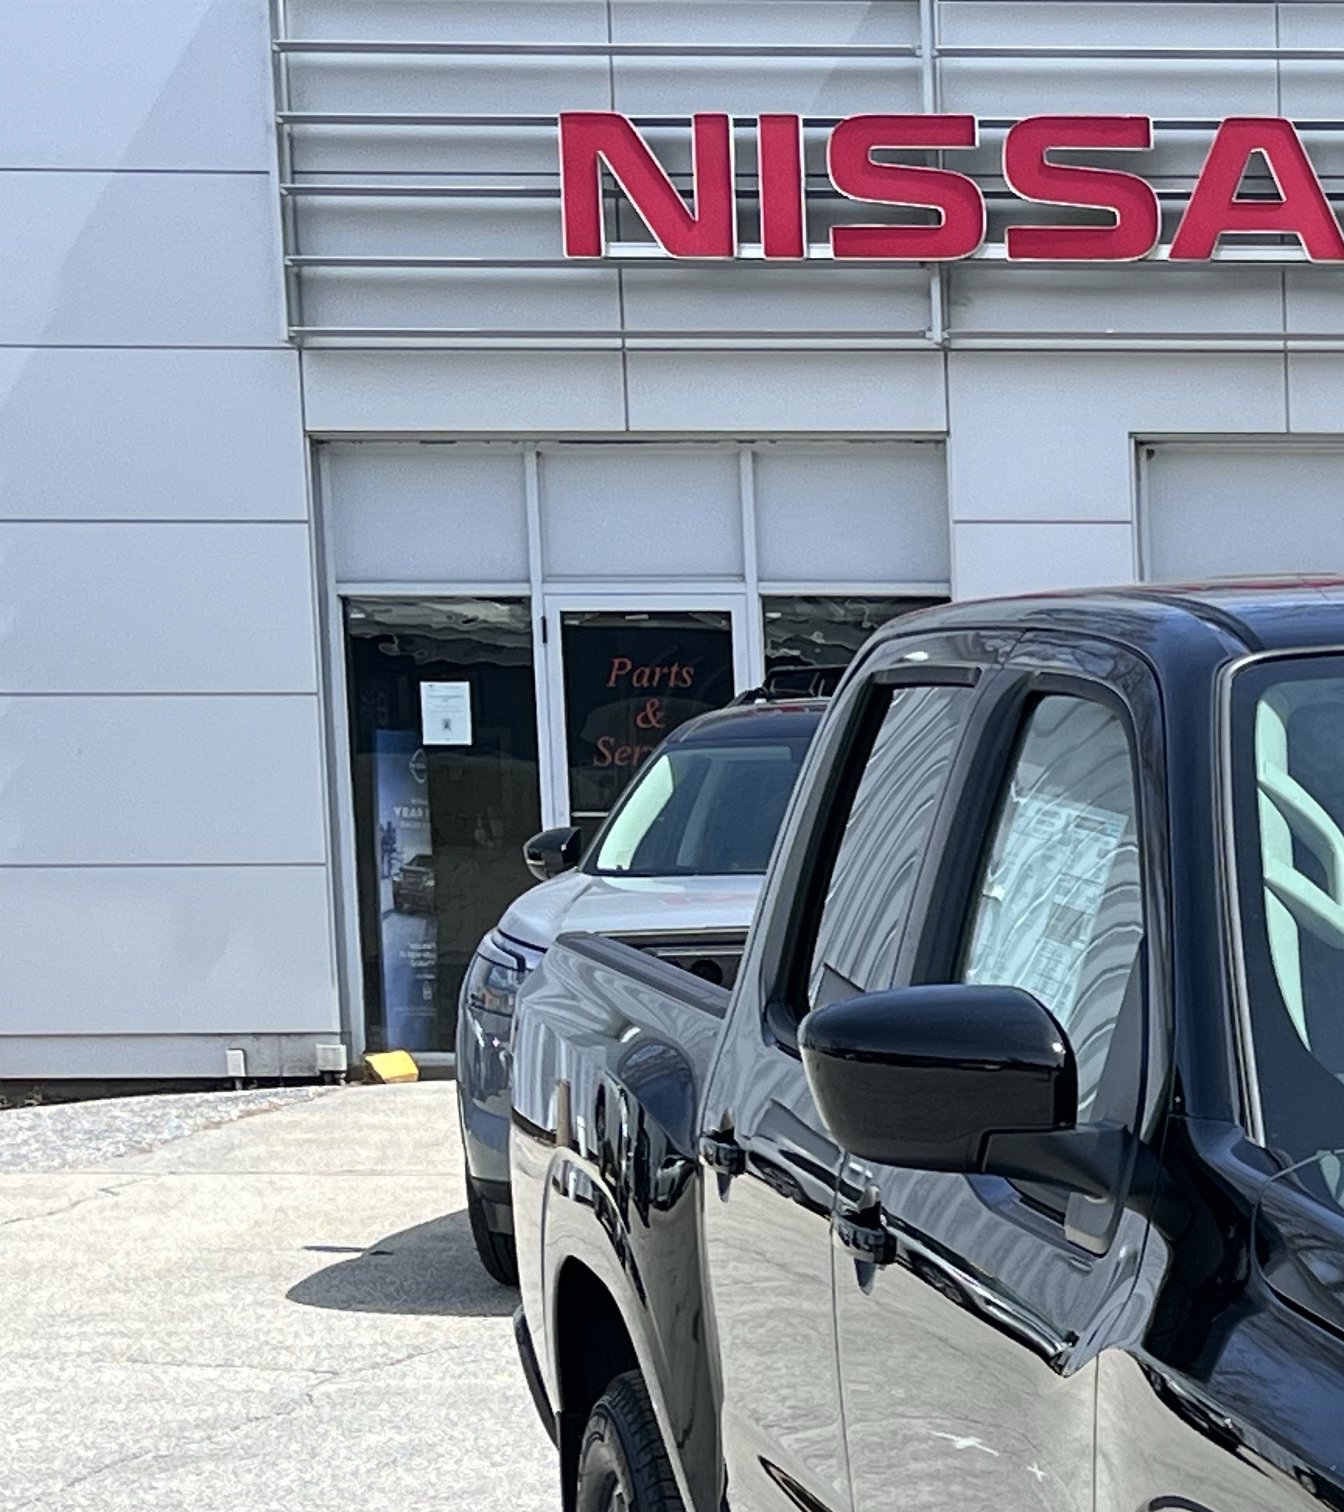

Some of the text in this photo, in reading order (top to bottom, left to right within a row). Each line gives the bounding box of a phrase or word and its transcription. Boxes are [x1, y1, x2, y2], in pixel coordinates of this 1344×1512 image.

[606, 657, 695, 688] Parts
[636, 698, 665, 729] &
[593, 735, 656, 767] Ser
